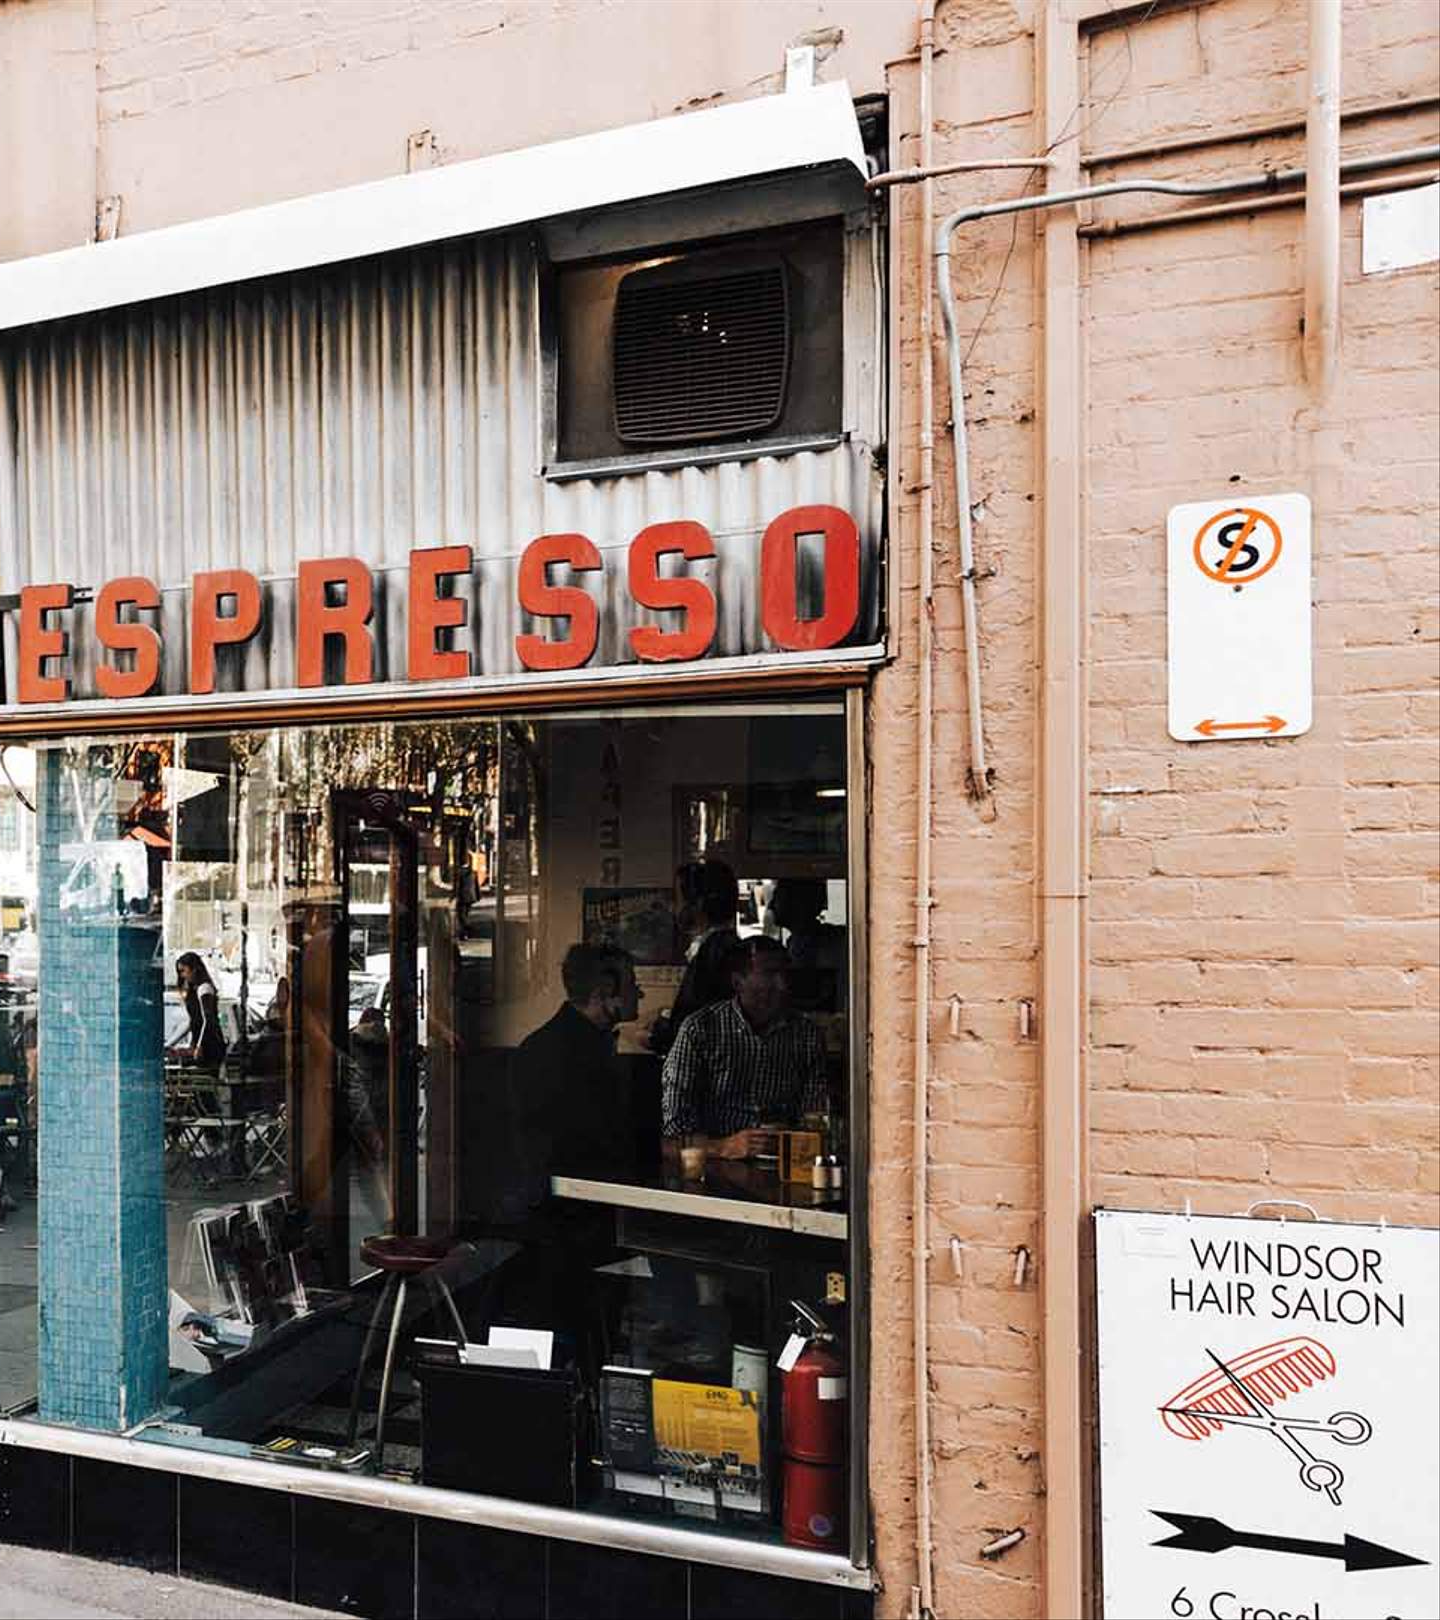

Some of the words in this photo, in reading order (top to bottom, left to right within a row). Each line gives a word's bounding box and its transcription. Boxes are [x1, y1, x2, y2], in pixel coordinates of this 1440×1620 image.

[1216, 522, 1260, 572] S
[17, 504, 862, 705] ESPRESSO
[1190, 1238, 1382, 1285] WINDSOR
[1170, 1278, 1257, 1316] HAIR
[1271, 1284, 1406, 1328] SALON
[1171, 1587, 1194, 1618] 6
